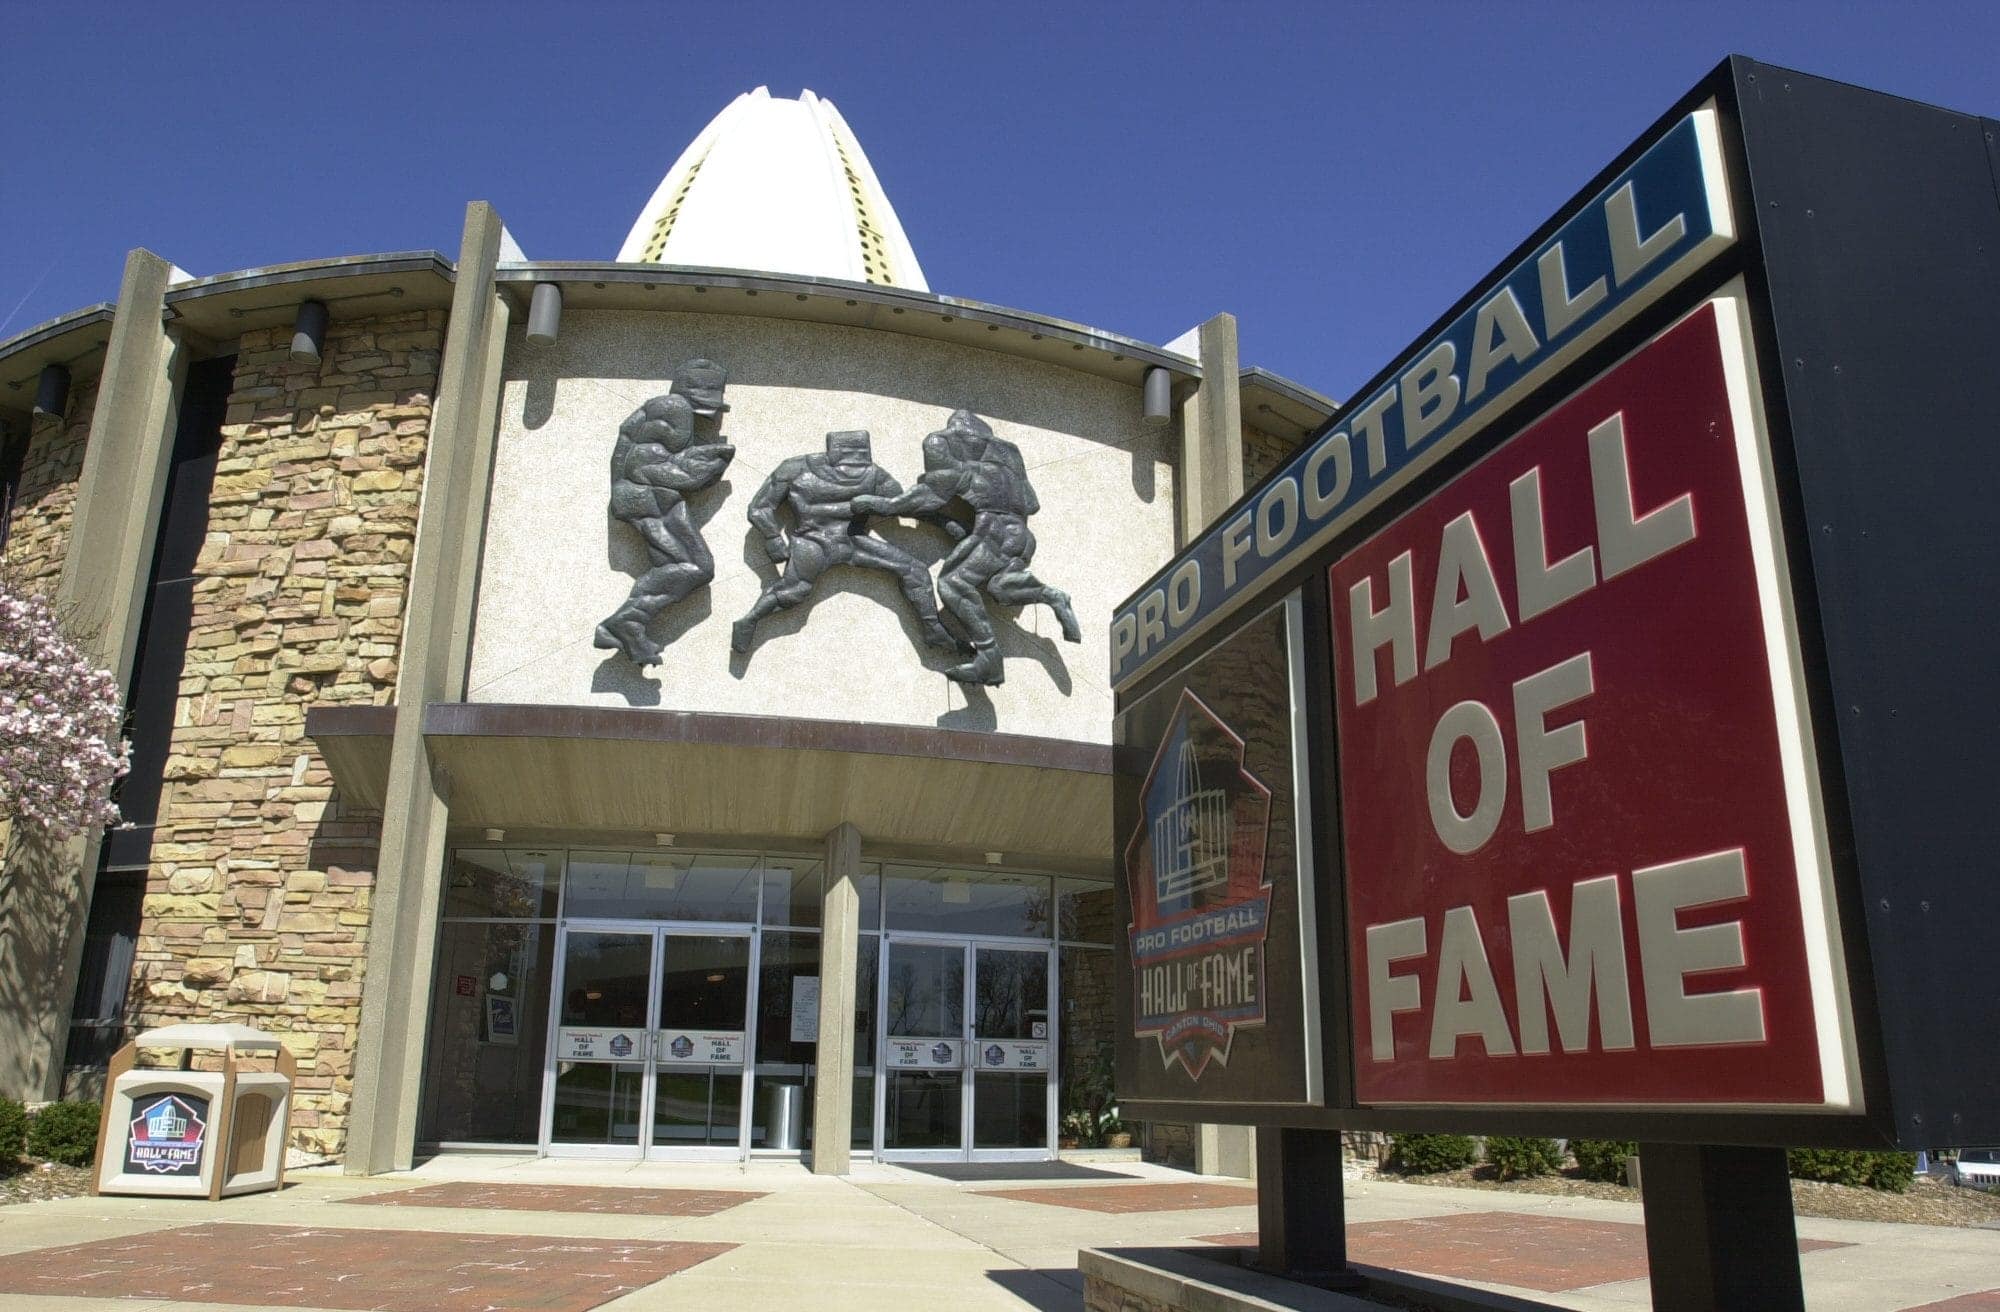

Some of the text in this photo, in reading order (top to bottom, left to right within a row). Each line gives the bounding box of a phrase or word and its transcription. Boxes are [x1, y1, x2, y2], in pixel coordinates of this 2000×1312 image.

[1110, 181, 1687, 675] PRO FOOTBALL
[1350, 411, 1697, 707] HALL
[1426, 652, 1594, 854] OF
[1136, 908, 1259, 953] PRO FOOTBALL
[1141, 947, 1256, 1016] HALL OF FAME
[1366, 847, 1767, 1062] FAME
[1202, 1017, 1224, 1037] OHIO
[136, 1147, 161, 1159] HALL
[168, 1148, 193, 1160] FAME
